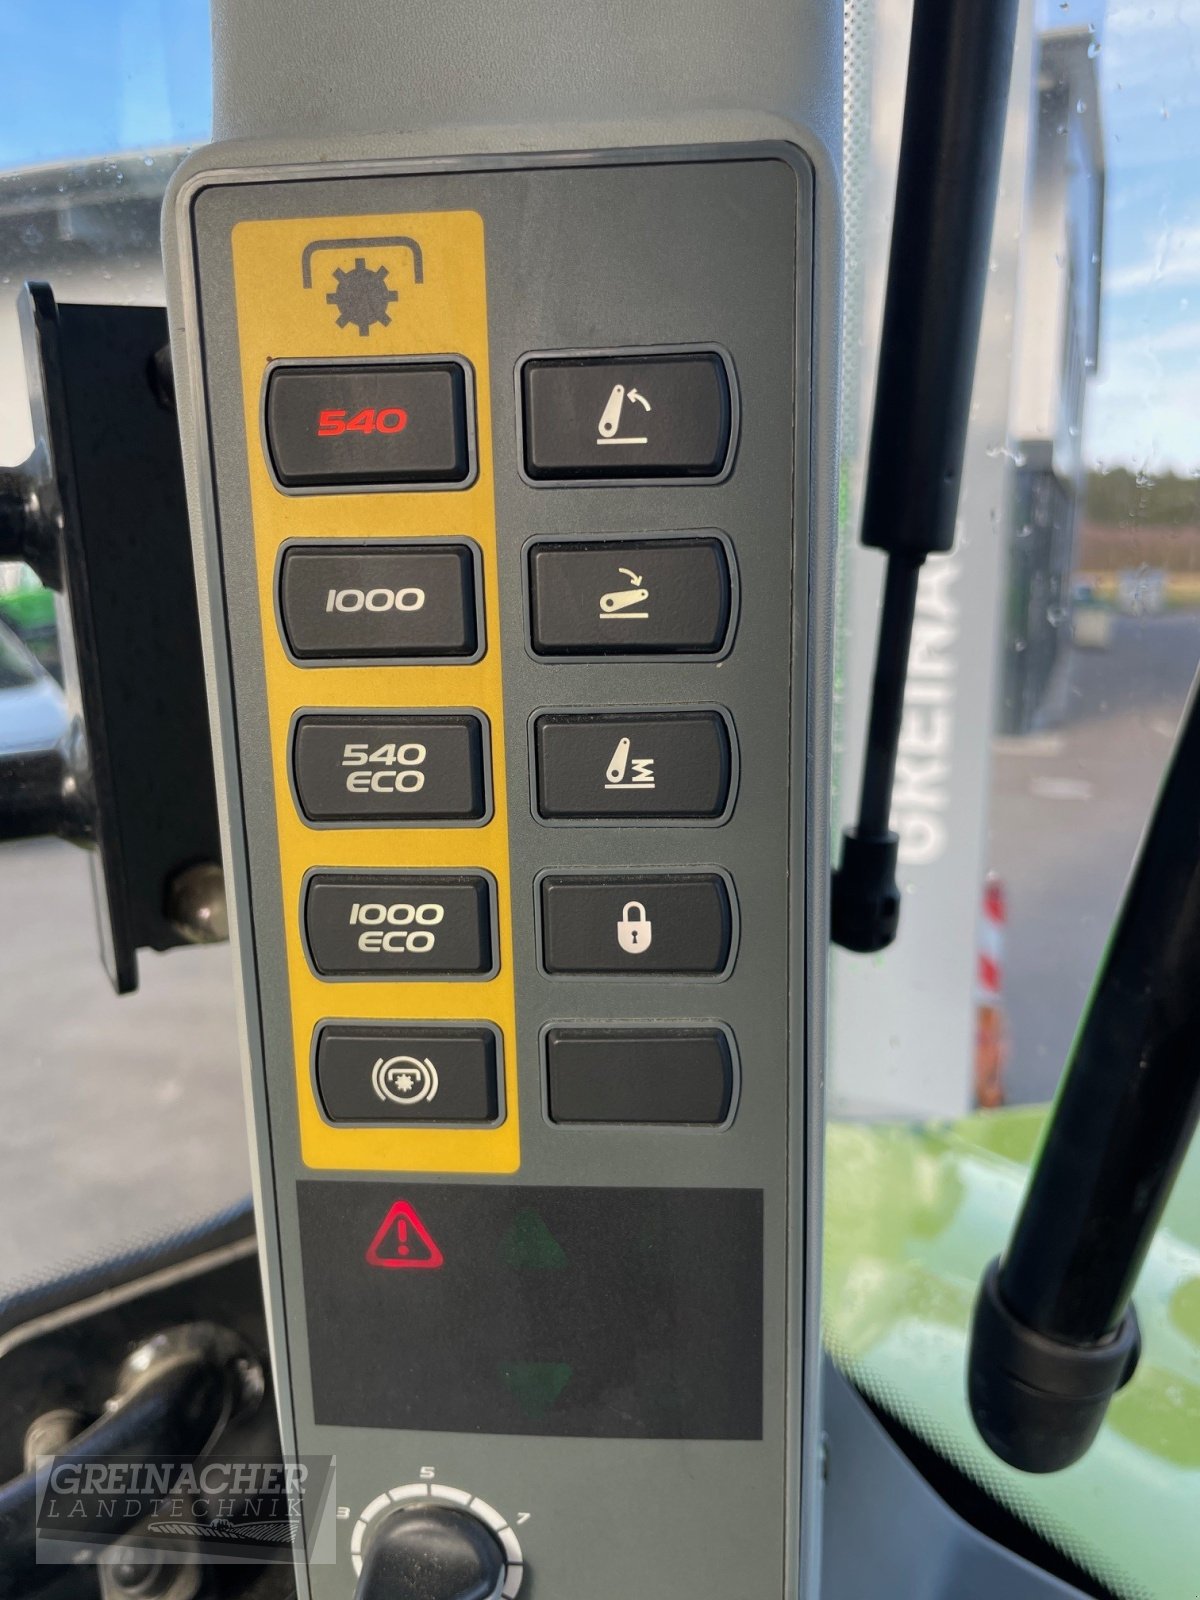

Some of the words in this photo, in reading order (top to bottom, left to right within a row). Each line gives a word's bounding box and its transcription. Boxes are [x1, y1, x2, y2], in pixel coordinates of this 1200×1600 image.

[317, 408, 408, 436] 540
[325, 587, 425, 612] 1000
[341, 743, 427, 766] 540
[346, 769, 425, 793] ECO
[349, 903, 445, 926] 1000
[357, 930, 436, 953] ECO
[419, 1466, 435, 1479] 5
[336, 1506, 351, 1520] 3
[516, 1512, 532, 1525] 7
